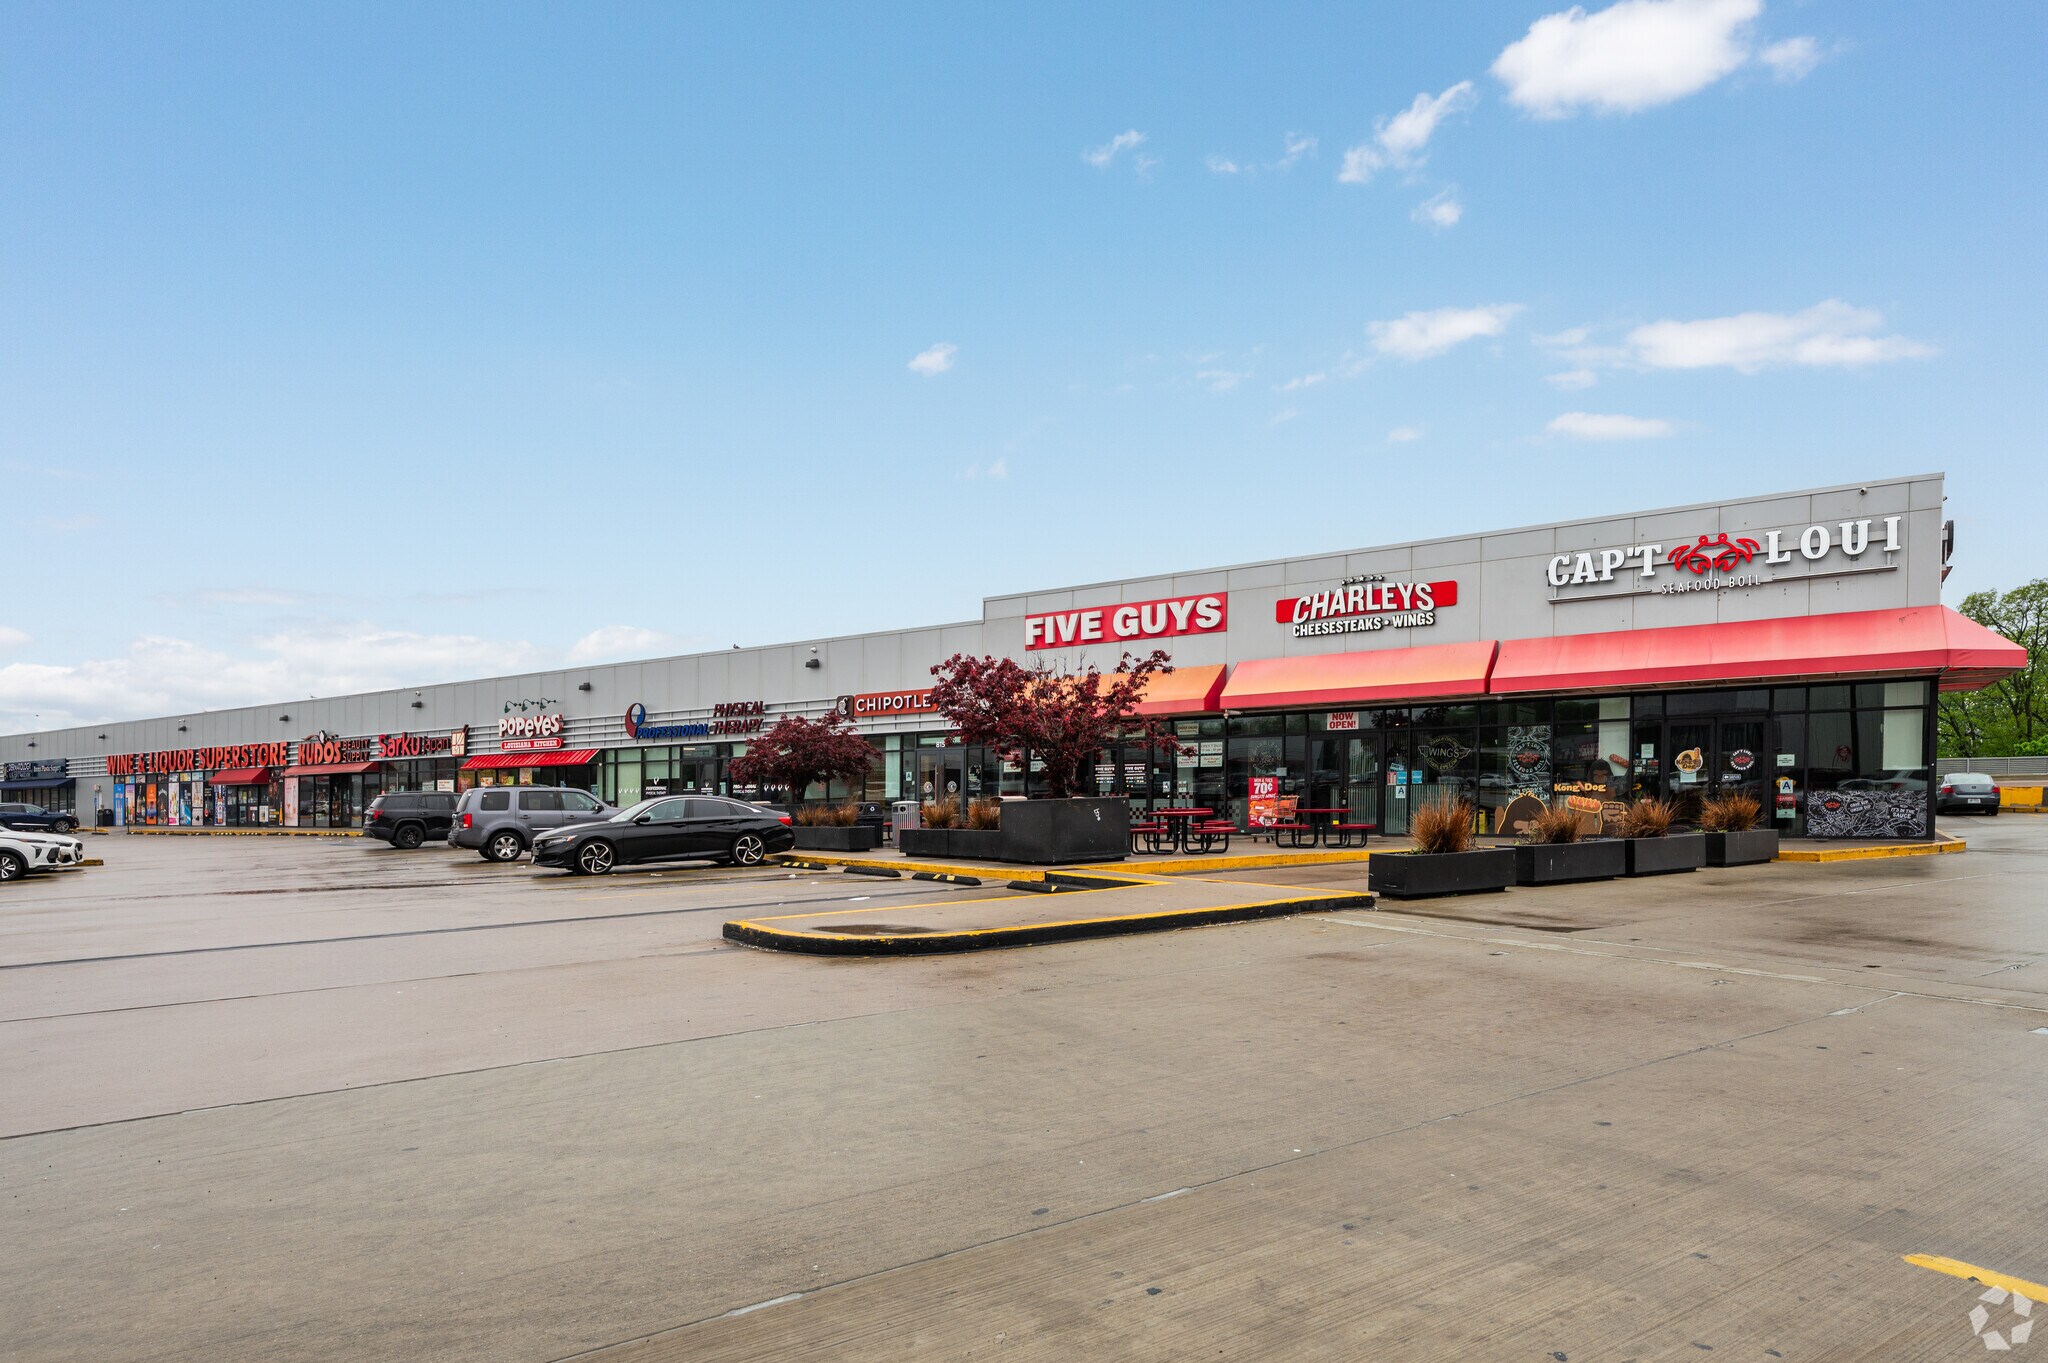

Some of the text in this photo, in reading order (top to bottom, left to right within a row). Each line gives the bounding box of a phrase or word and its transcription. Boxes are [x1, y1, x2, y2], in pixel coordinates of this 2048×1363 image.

[1548, 515, 1902, 586] CAP'T LOUI
[1661, 573, 1761, 595] SEAFOOD BOIL
[1292, 582, 1435, 624] CHARLEYS
[1025, 597, 1223, 646] FIVE GUYS
[1292, 612, 1435, 637] CHEESESTEAKS WINGS
[713, 701, 766, 718] PHYSICAL
[856, 693, 931, 712] CHIPOTLE
[1329, 721, 1356, 729] OPEN!
[1332, 713, 1354, 721] NOW
[636, 718, 764, 740] PROFESSIONAL THERAPY
[342, 738, 371, 751] BEAUTY
[378, 732, 421, 758] Sarku
[504, 739, 558, 749] LOUISIANA KITCHEN
[1429, 747, 1460, 759] WINGS
[106, 742, 288, 775] WINE & LIQUOR SUPERSTORE
[298, 741, 341, 766] KUDOS
[342, 751, 370, 762] SUPPLY
[1254, 782, 1273, 794] 70¢
[1554, 782, 1606, 792] Kong Dog
[1783, 781, 1791, 790] A
